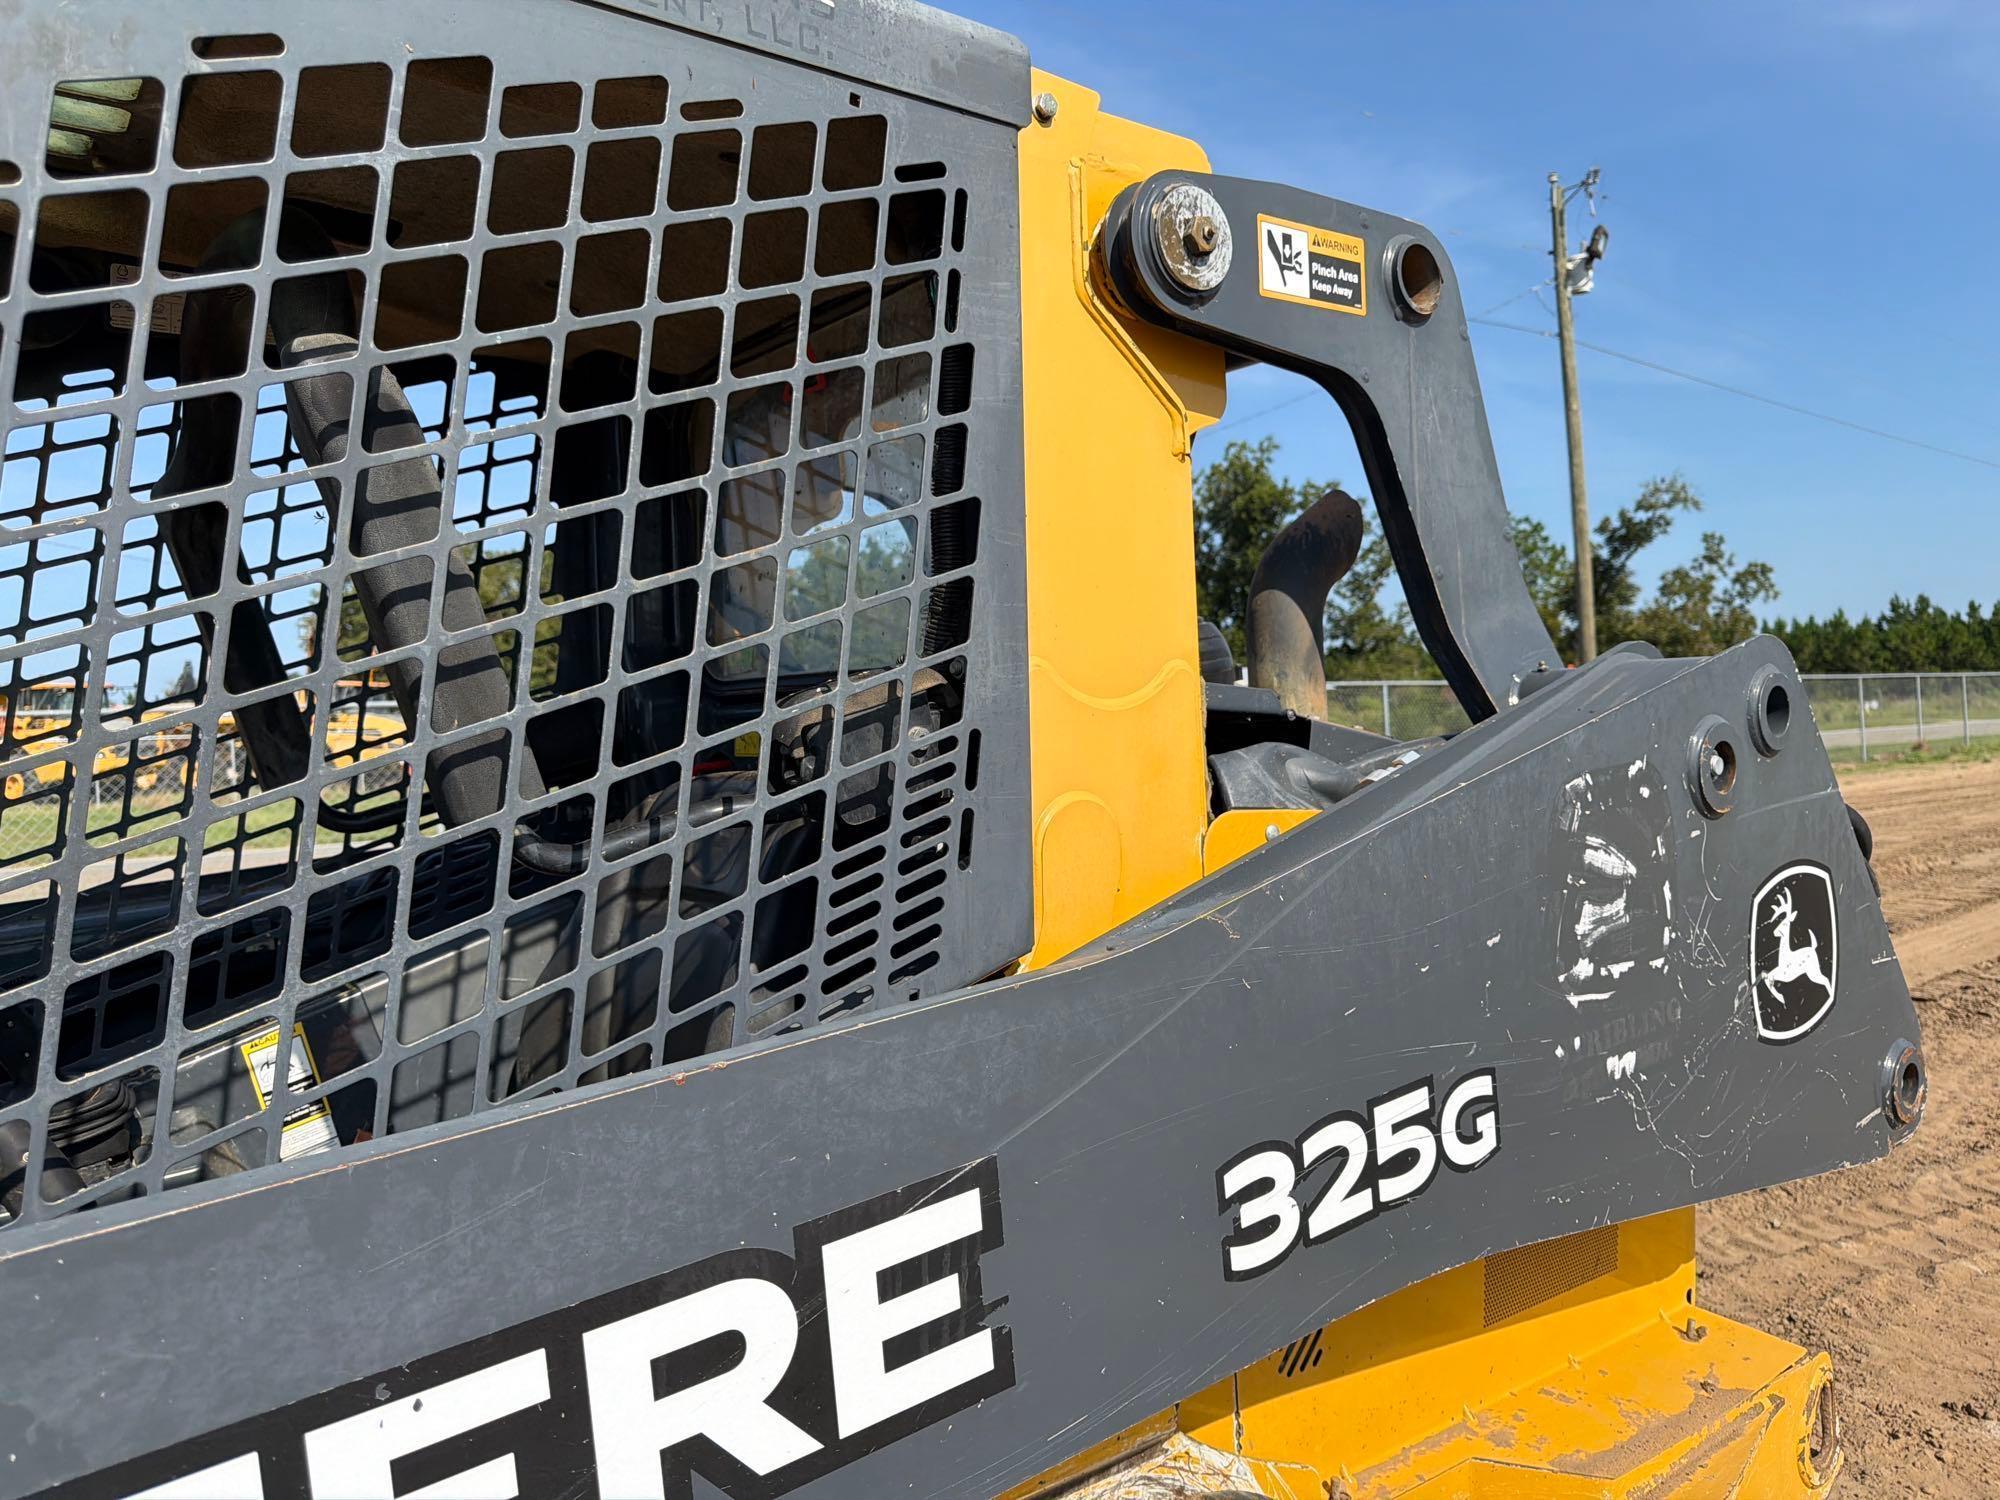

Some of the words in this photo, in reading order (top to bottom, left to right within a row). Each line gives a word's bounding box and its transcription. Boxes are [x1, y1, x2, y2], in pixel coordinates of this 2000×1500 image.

[1320, 238, 1359, 256] WARNING
[1312, 262, 1337, 279] Pinch
[1339, 269, 1359, 284] Area
[1312, 280, 1332, 295] Keep
[1333, 284, 1353, 299] Away
[1223, 1074, 1497, 1272] 325G
